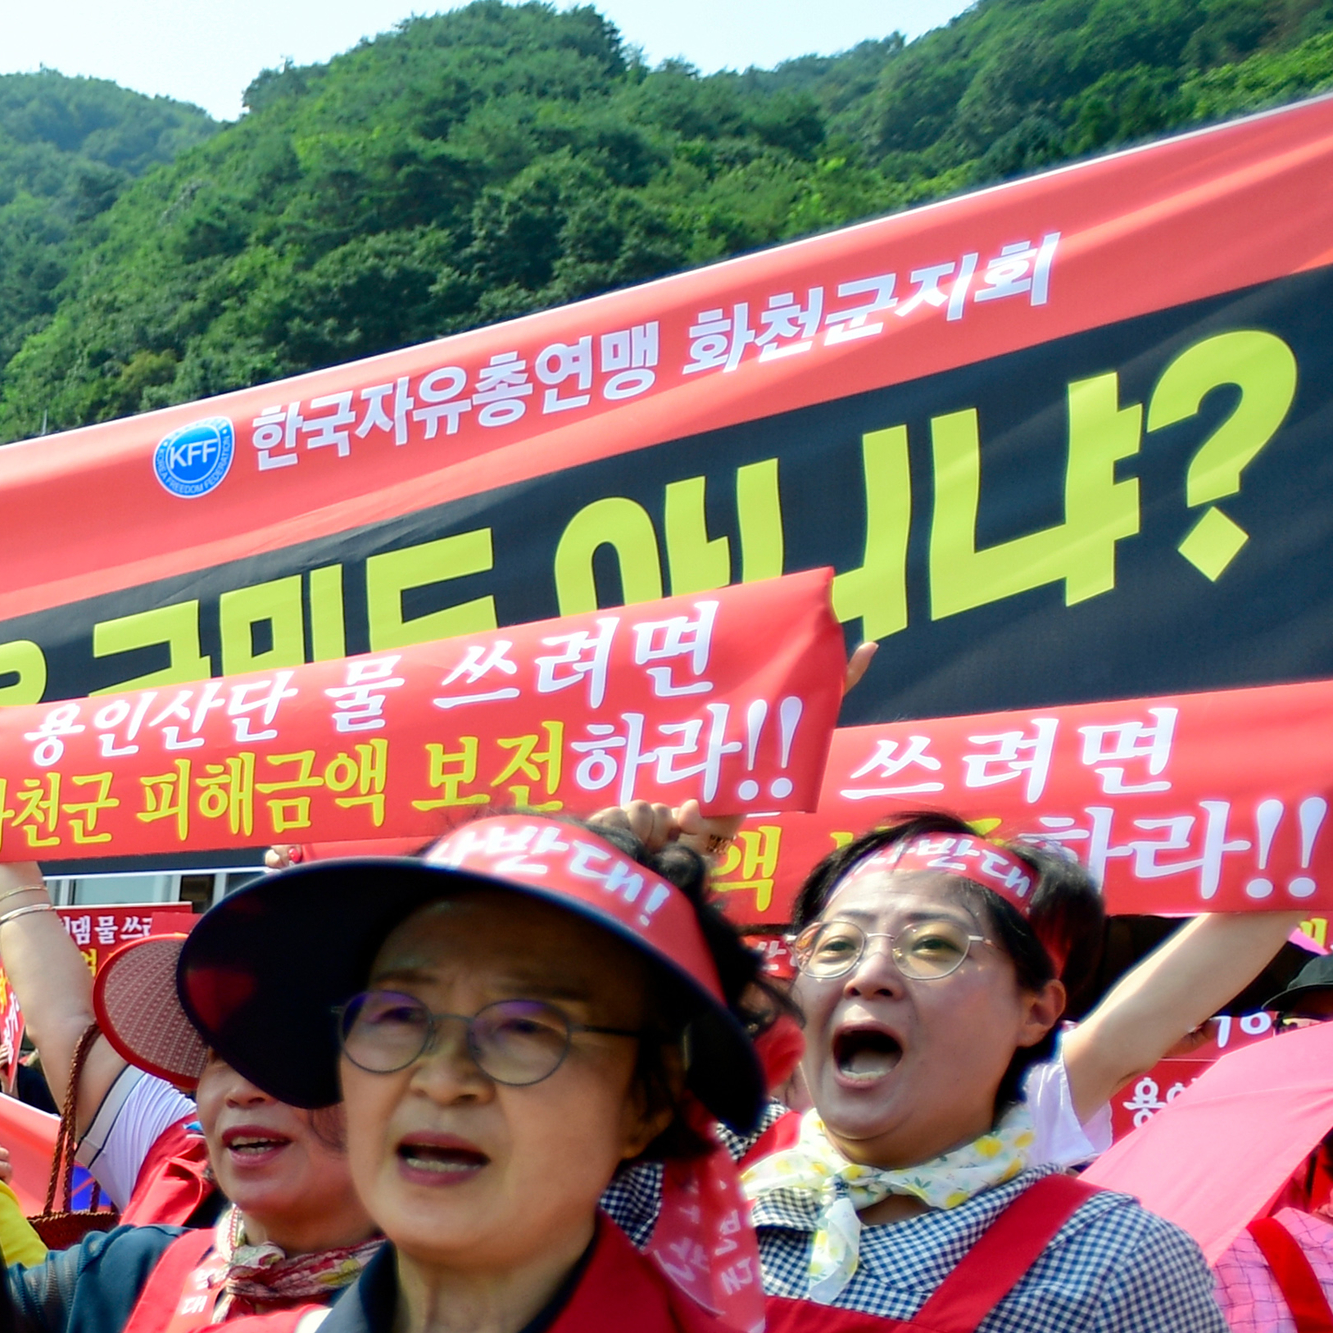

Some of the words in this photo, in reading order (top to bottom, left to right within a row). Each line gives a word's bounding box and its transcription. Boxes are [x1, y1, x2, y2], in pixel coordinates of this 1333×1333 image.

[253, 322, 659, 472] 한국자유총연맹
[683, 232, 1061, 375] 화천군지회
[169, 438, 219, 469] KFF
[554, 329, 1298, 643] 아니냐?
[23, 669, 298, 768] 용인산단
[324, 654, 406, 734] 물
[433, 599, 721, 710] 쓰려면
[135, 739, 391, 841] 피해금액
[411, 694, 805, 814] 보전하라!!
[840, 707, 1180, 803] 쓰려면
[830, 797, 1329, 900] 하라!!
[95, 915, 119, 945] 물
